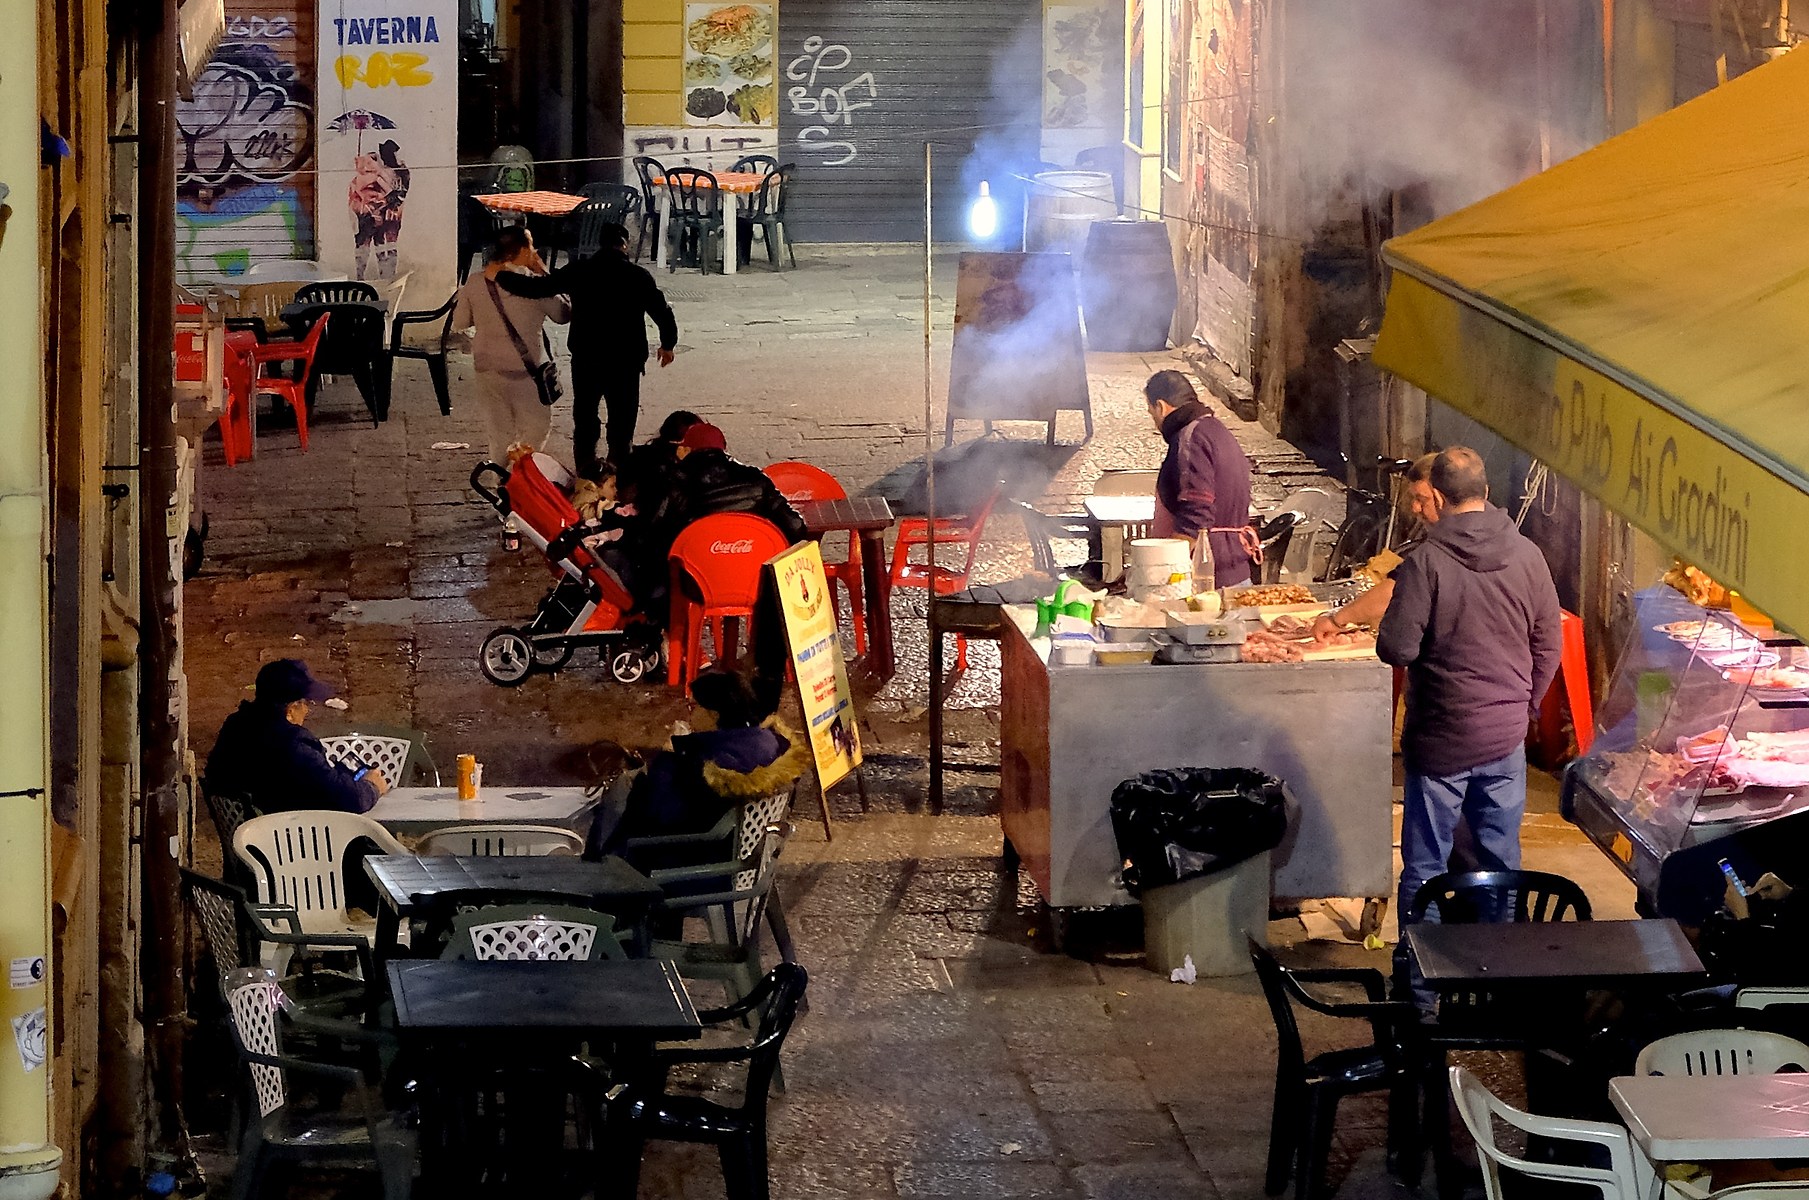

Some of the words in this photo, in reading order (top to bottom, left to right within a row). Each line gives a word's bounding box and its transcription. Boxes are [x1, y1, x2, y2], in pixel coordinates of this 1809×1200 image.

[333, 16, 440, 46] TAVERNA
[1563, 379, 1613, 491] Pub
[1626, 416, 1654, 517] Ai
